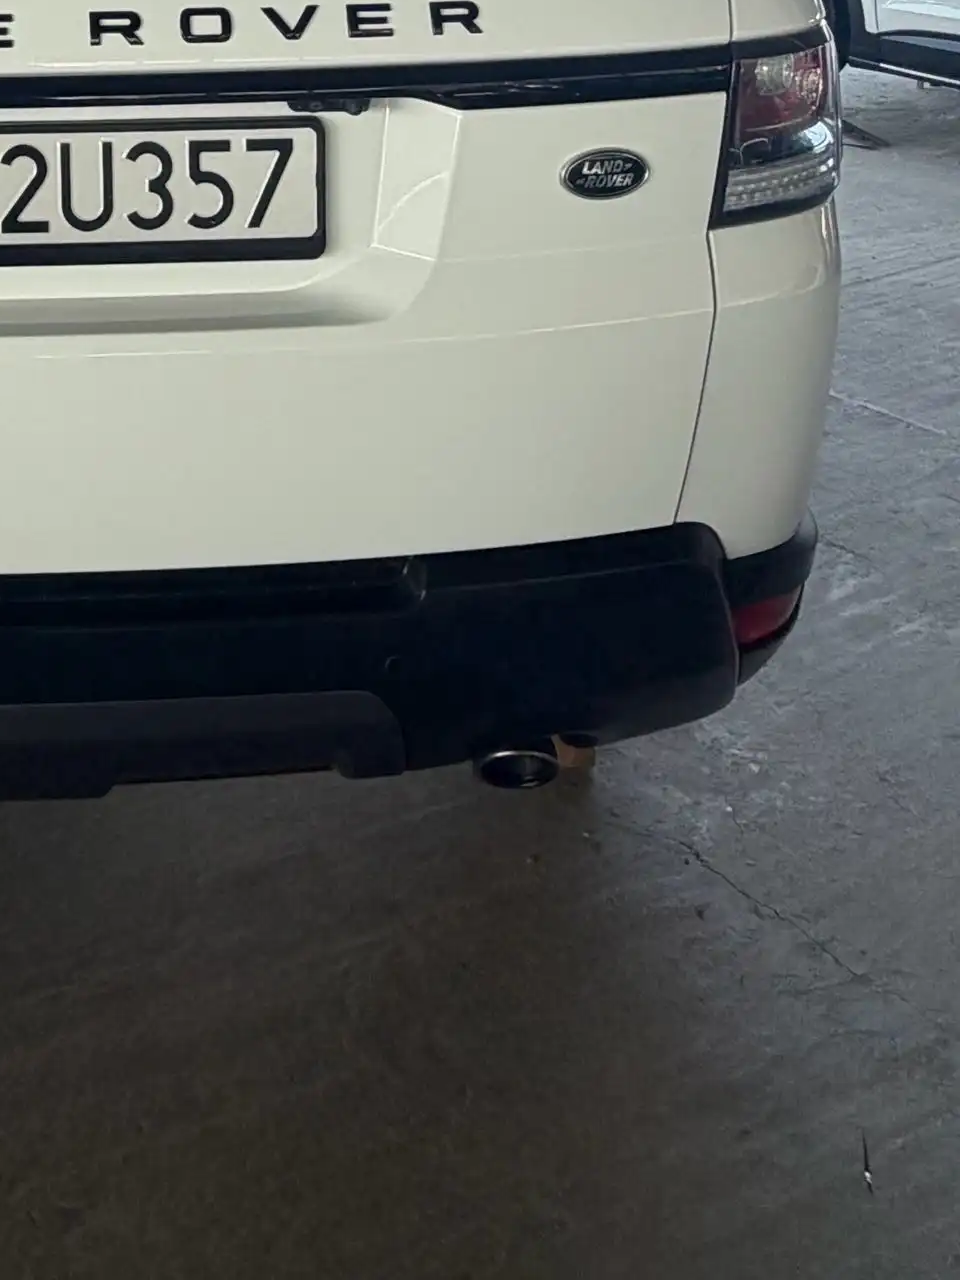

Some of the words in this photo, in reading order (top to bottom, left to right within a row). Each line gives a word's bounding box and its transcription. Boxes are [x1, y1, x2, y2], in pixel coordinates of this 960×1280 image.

[88, 0, 484, 46] ROVER
[581, 159, 624, 175] LAND
[583, 172, 635, 189] ROVER
